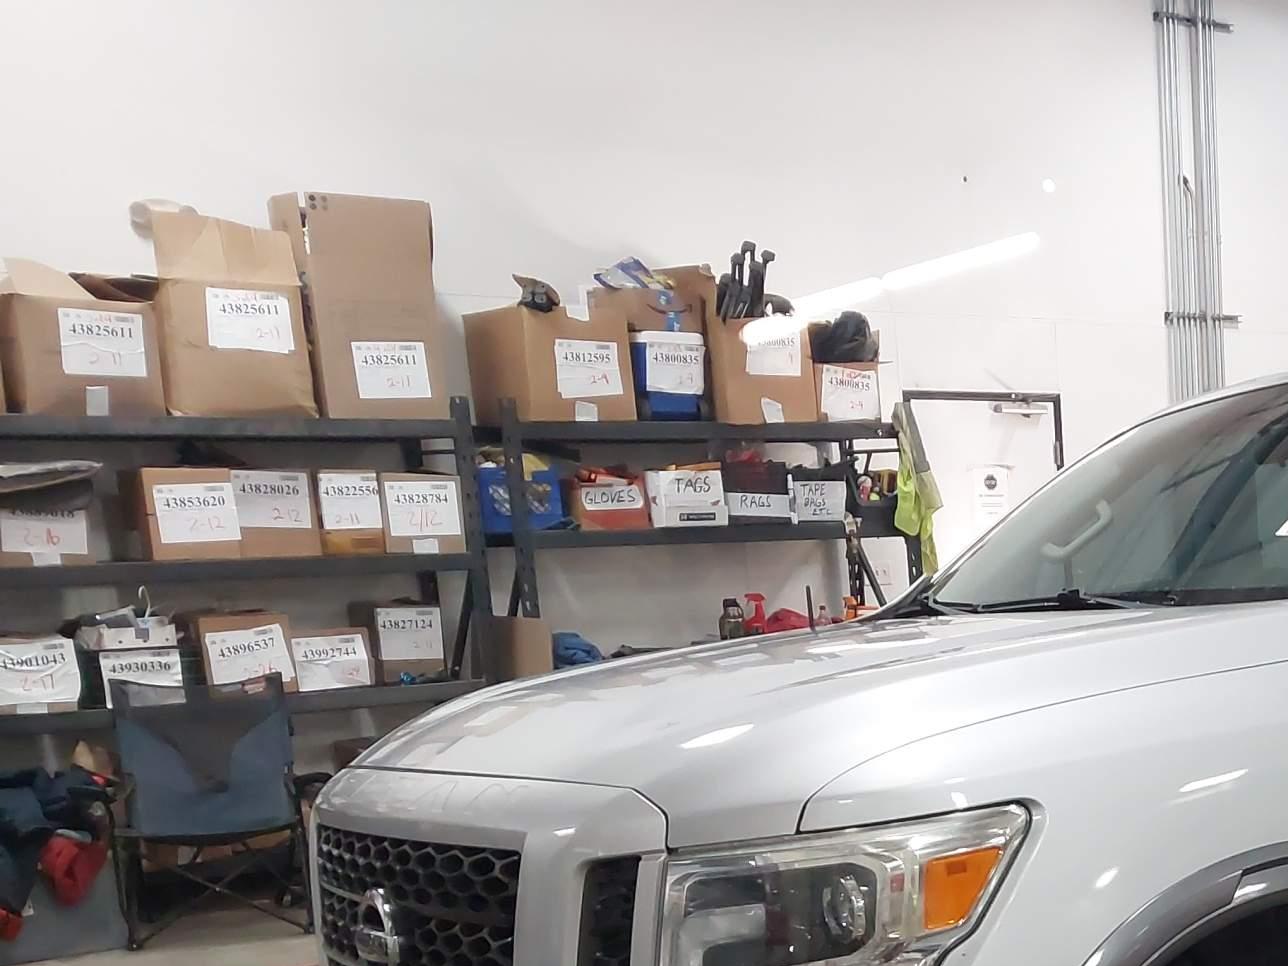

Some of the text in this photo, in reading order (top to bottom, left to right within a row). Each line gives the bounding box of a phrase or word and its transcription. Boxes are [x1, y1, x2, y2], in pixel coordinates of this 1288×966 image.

[219, 303, 279, 315] 43825611
[68, 322, 133, 338] 43825611
[361, 354, 417, 366] 43825611
[562, 351, 611, 364] 43812595
[652, 351, 699, 364] 43800835
[828, 376, 870, 391] 43800835
[239, 483, 300, 496] 43828026
[322, 485, 379, 497] 43822556
[674, 475, 712, 494] TAGS
[800, 483, 826, 497] TAPE
[163, 495, 226, 509] 43853620
[394, 493, 448, 504] 43828784
[584, 488, 636, 505] GLOVES
[740, 494, 772, 508] RAGS
[804, 497, 826, 508] BAGS
[379, 619, 433, 630] 43827124
[218, 637, 276, 659] 43896537
[301, 646, 357, 660] 43992744
[109, 660, 171, 674] 43930336
